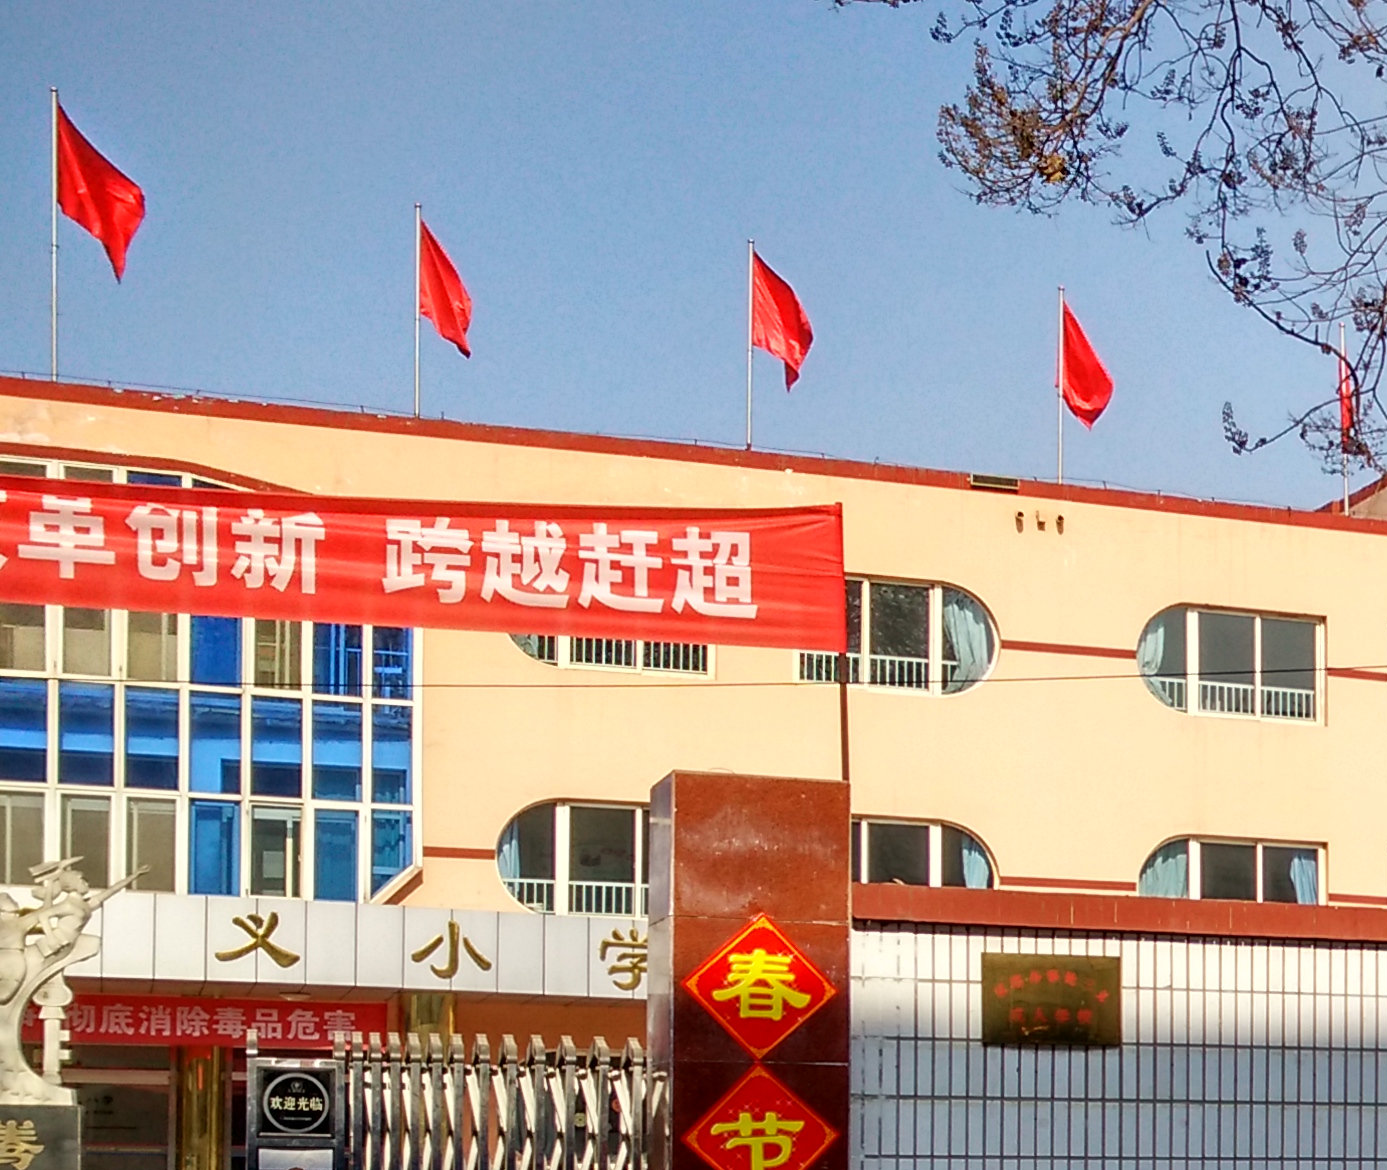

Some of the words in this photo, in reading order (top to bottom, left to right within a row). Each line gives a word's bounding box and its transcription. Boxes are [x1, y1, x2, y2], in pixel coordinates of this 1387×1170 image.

[0, 491, 327, 595] 革创新
[382, 516, 758, 619] 跨越赶超
[269, 1095, 323, 1112] 欢迎光临
